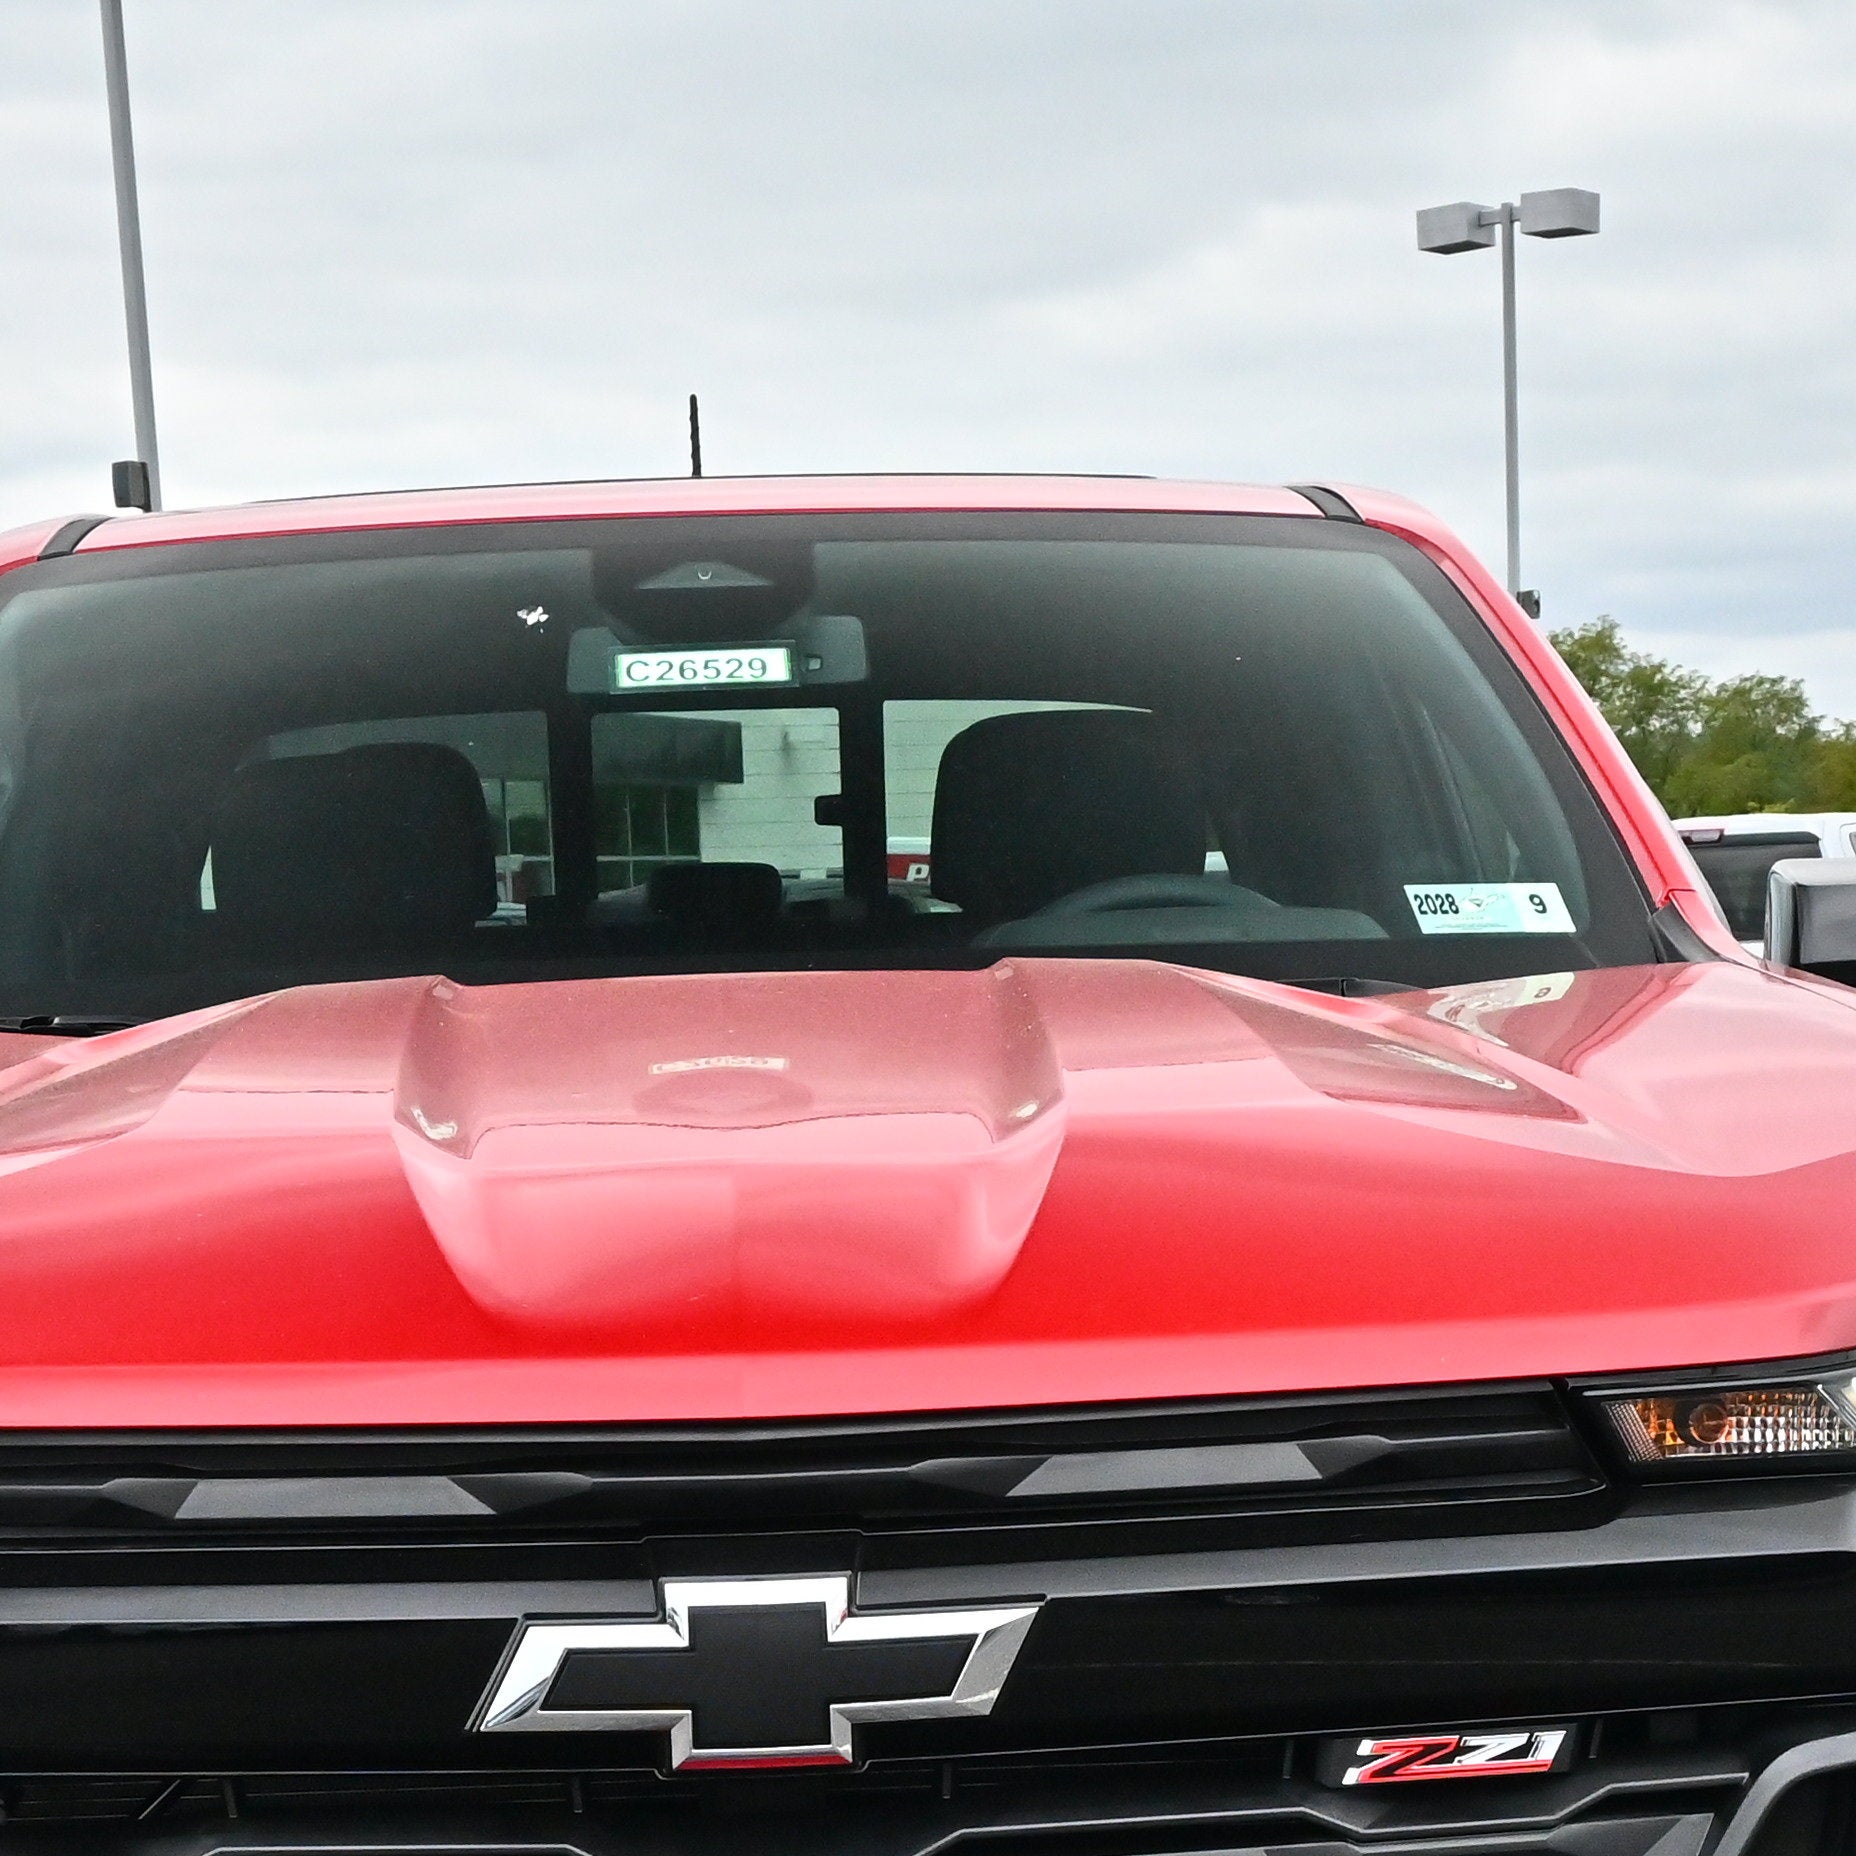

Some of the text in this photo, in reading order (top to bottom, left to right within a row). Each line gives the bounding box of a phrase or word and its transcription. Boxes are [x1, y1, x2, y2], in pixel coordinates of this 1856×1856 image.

[626, 657, 768, 682] C26529
[1413, 893, 1548, 915] 2028 9
[1342, 1730, 1567, 1785] Z71
